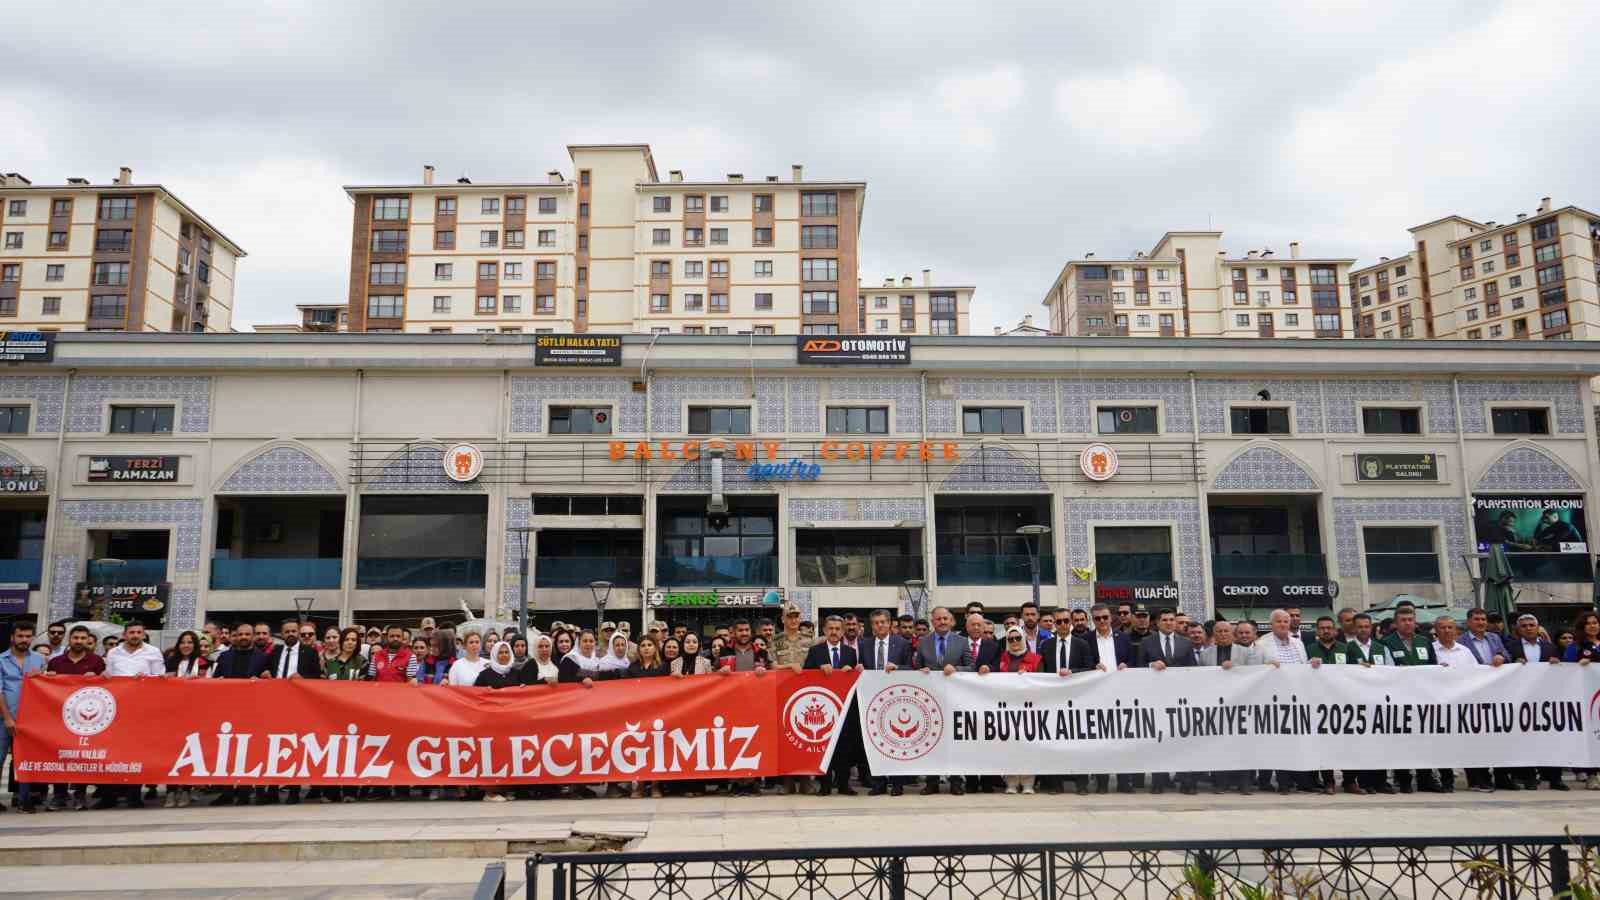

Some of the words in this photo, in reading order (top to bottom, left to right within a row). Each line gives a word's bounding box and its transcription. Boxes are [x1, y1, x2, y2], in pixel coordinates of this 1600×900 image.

[537, 336, 565, 346] SÜTLÜ
[567, 338, 595, 346] HALKA
[597, 338, 619, 346] TATLI
[841, 339, 906, 352] OTOMOTİV
[819, 440, 960, 461] COFFEE
[128, 456, 164, 469] TERZİ
[112, 470, 175, 480] RAMAZAN
[1544, 499, 1583, 509] SALONU
[1134, 585, 1178, 599] KUAFÖR
[1282, 585, 1324, 595] COFFEE
[667, 591, 718, 606] FANUS
[724, 595, 758, 605] CAFE
[953, 710, 978, 742] EN
[984, 702, 1050, 742] BÜYÜK
[1055, 699, 1163, 743] AİLEMİZİN,
[1165, 694, 1312, 738] TÜRKİYE'MİZİN
[1316, 702, 1367, 735] 2025
[1371, 695, 1412, 735] AİLE
[1416, 703, 1452, 735] YILI
[1456, 702, 1514, 735] KUTLU
[1518, 700, 1583, 733] OLSUN
[168, 721, 394, 779] AİLEMİZ
[407, 715, 762, 779] GELECEĞİMİZ
[18, 759, 33, 771] AİLE
